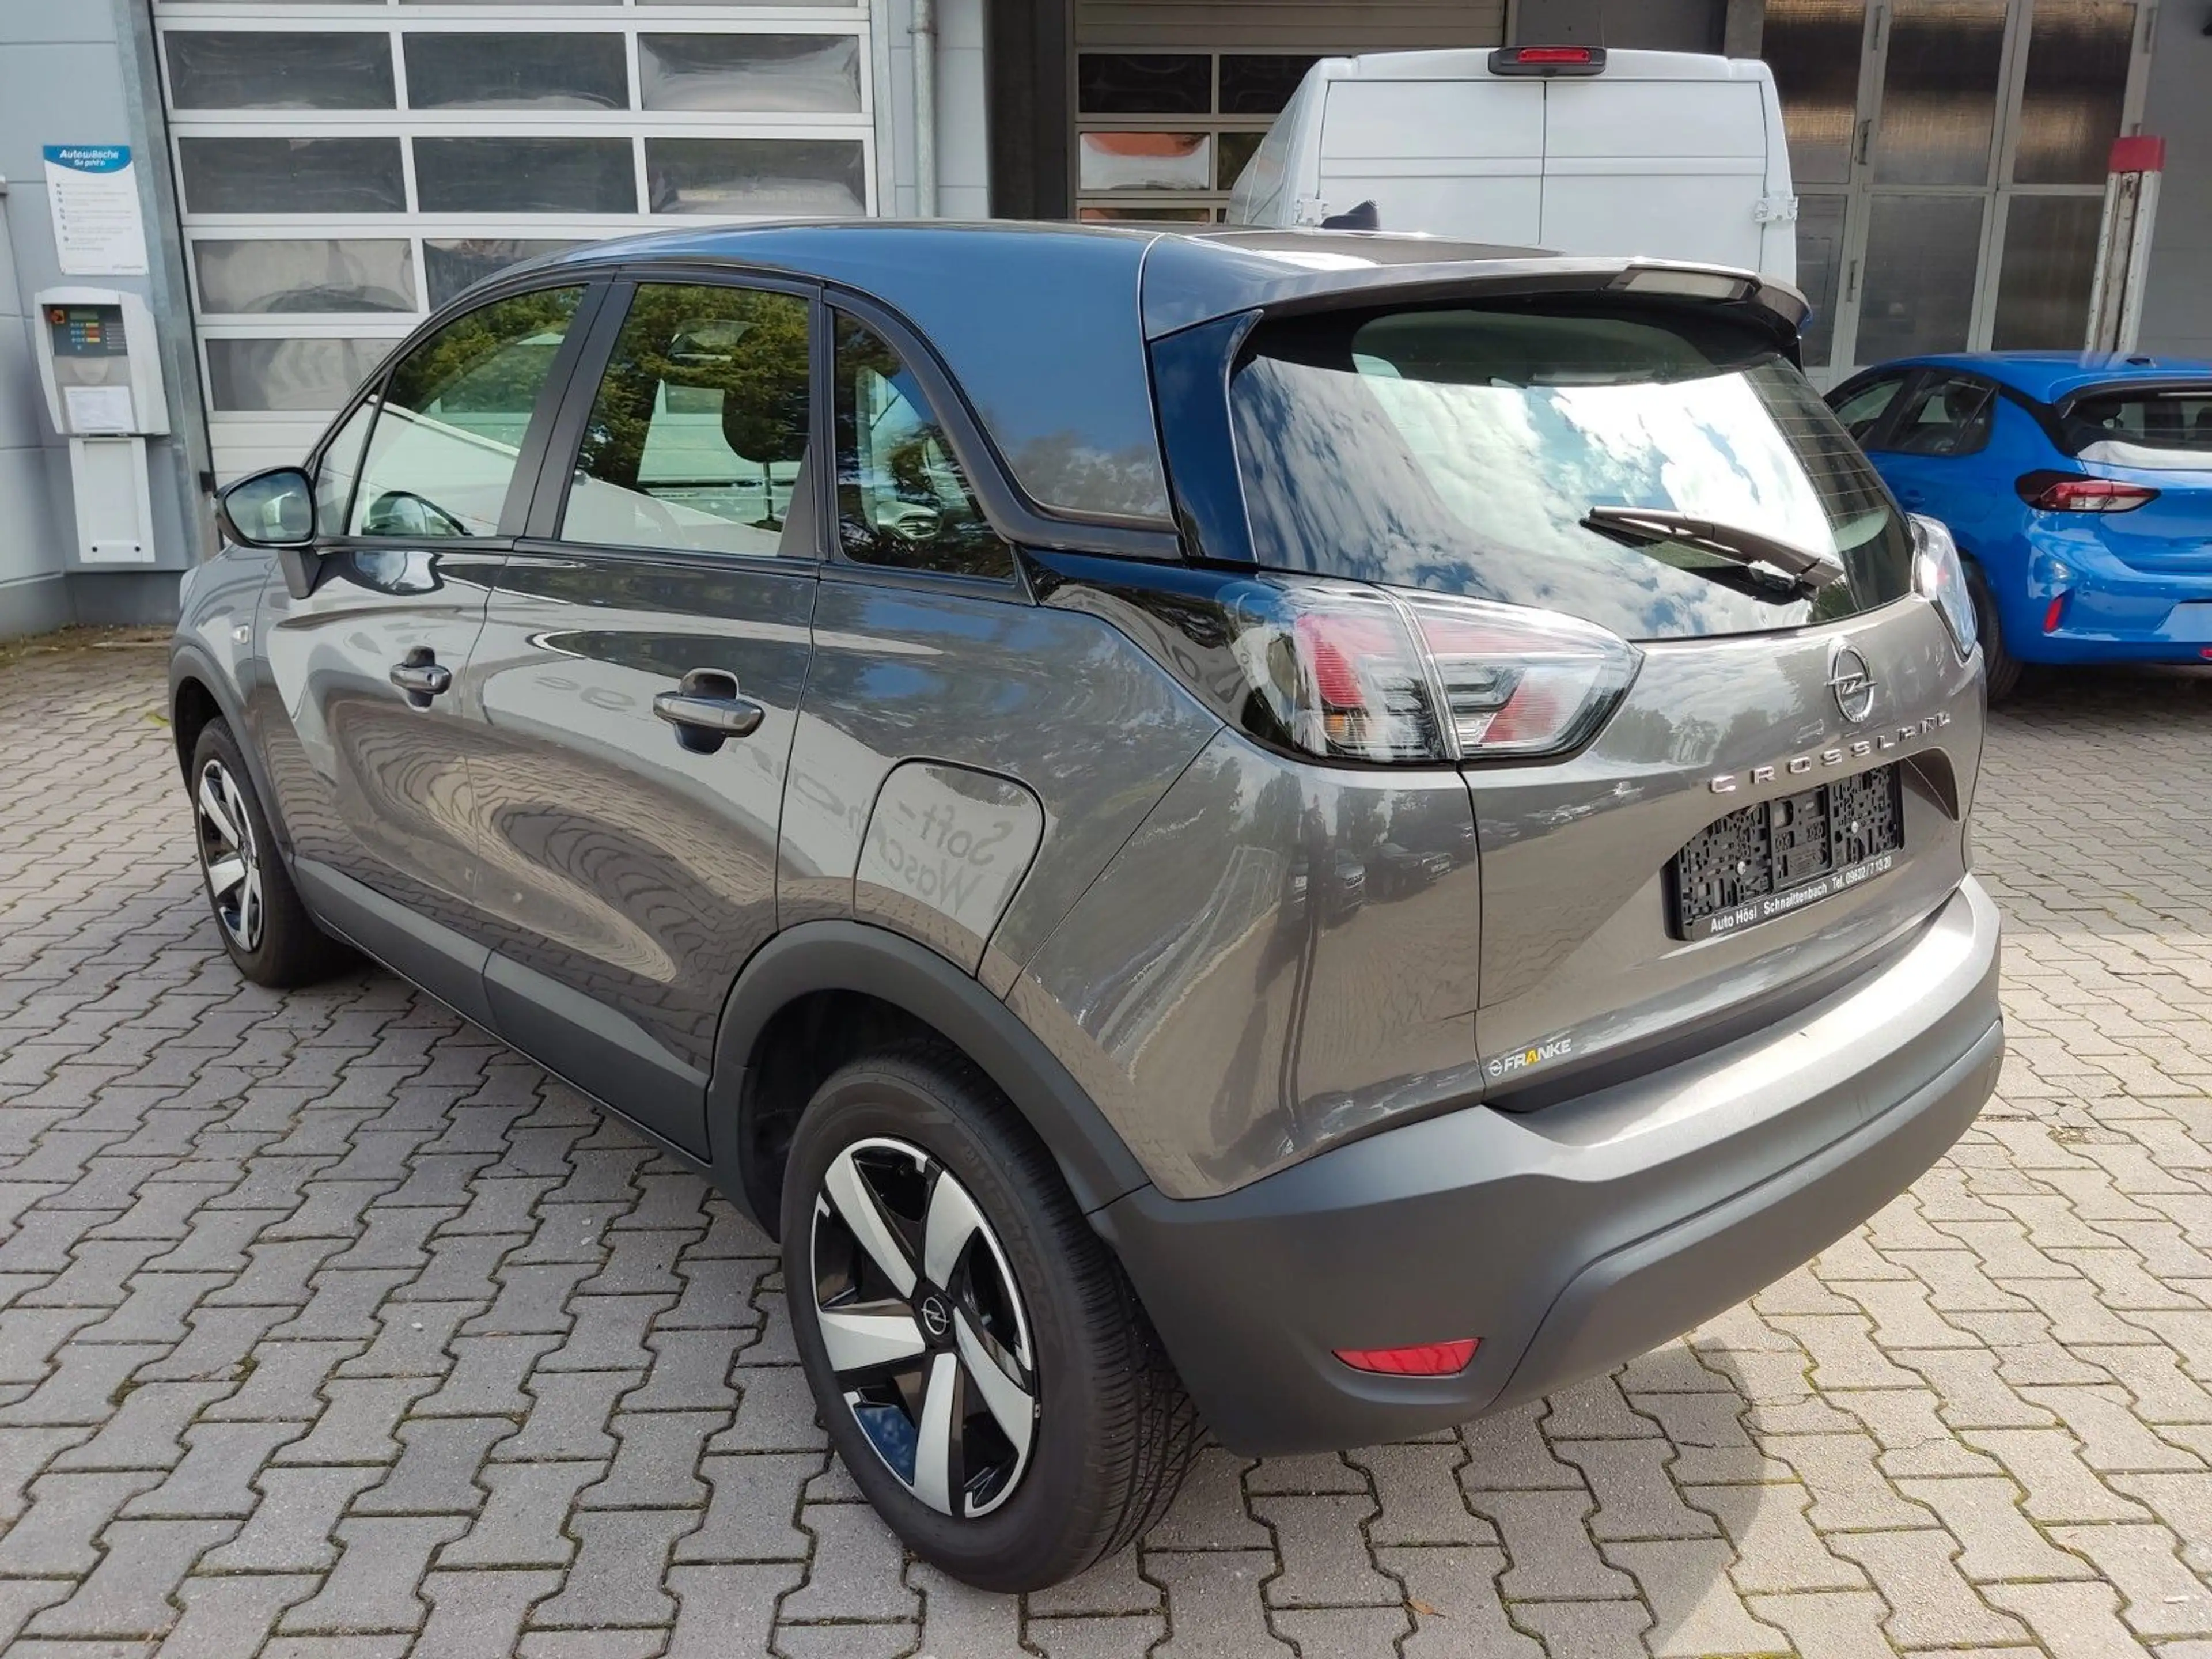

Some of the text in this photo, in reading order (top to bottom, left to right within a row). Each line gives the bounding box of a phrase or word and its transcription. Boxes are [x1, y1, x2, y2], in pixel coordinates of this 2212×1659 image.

[1710, 915, 1734, 933] Auto
[1736, 906, 1757, 924] Hösl
[1763, 881, 1827, 915] Schnaittenbach
[1832, 875, 1845, 889] Tel.
[1504, 1038, 1571, 1072] FRANKE
